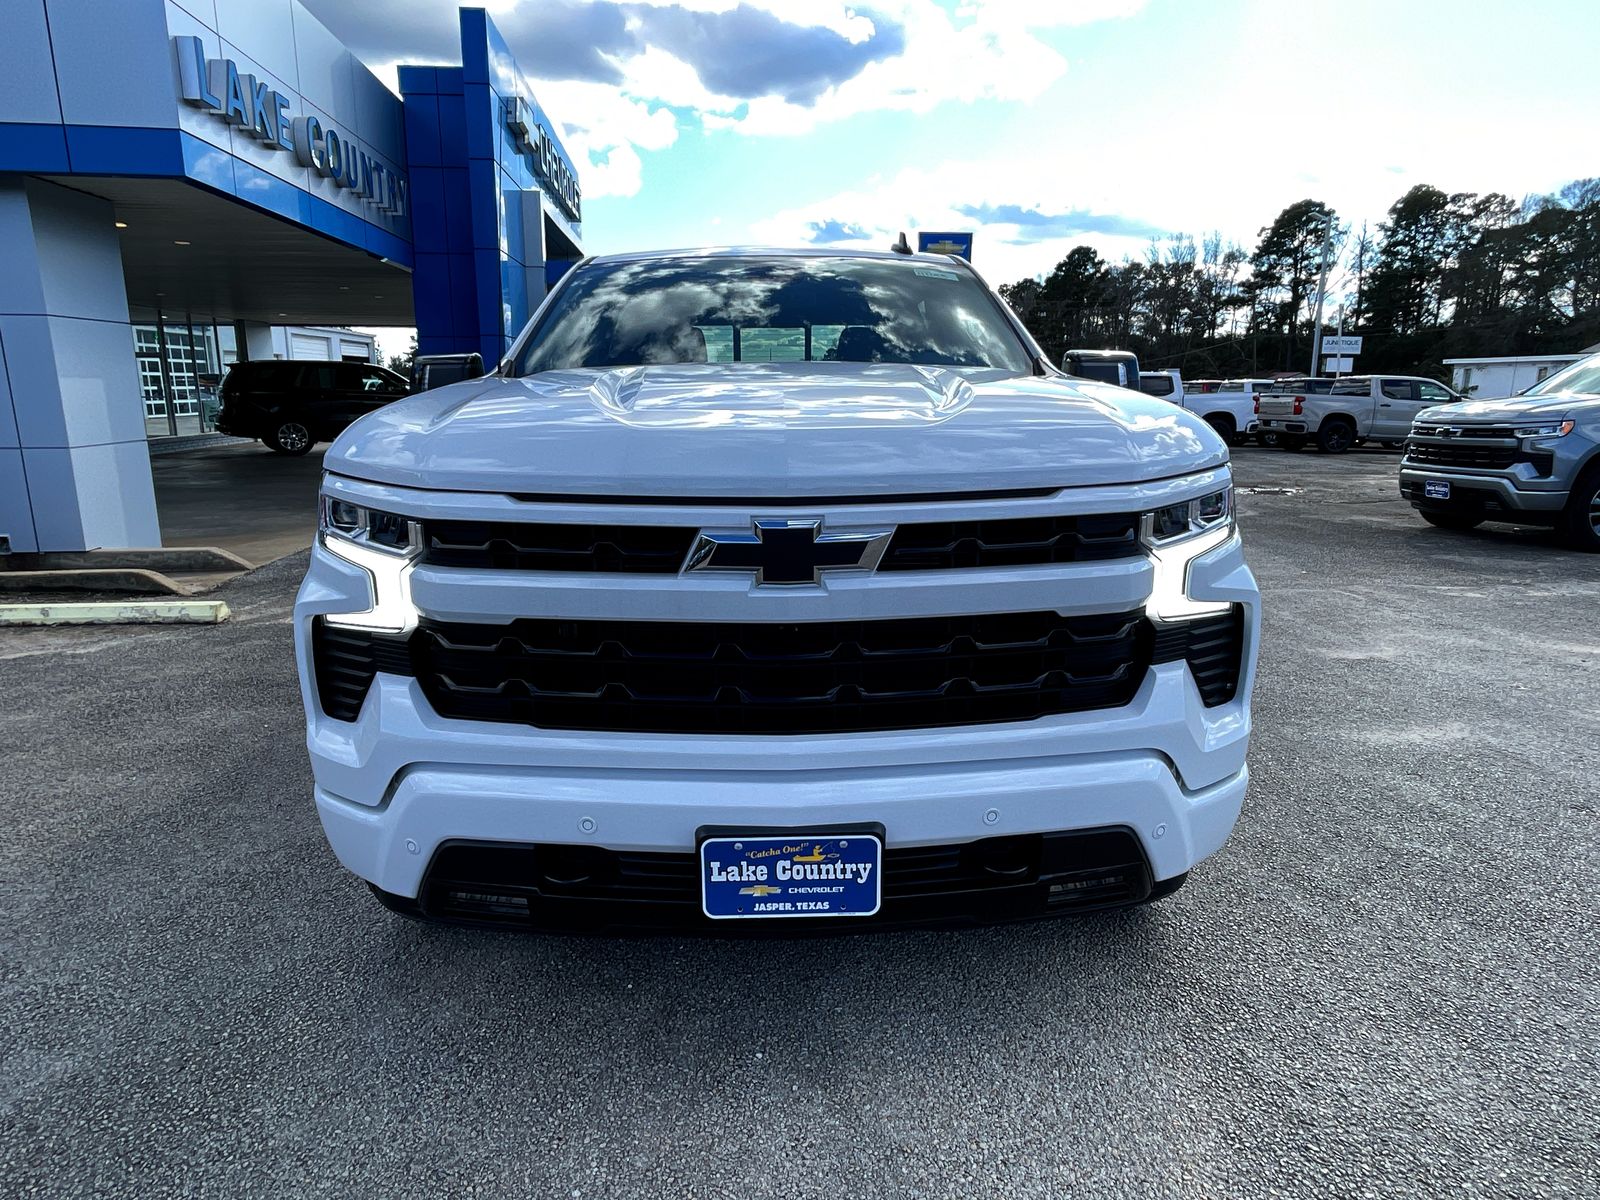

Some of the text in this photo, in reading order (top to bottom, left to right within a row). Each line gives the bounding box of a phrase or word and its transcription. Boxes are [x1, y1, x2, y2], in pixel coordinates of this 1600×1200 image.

[184, 36, 407, 214] LAKE COUNTRY
[710, 859, 872, 884] Lake Country
[788, 886, 845, 894] CHEVROLET
[796, 901, 830, 911] TEXAS
